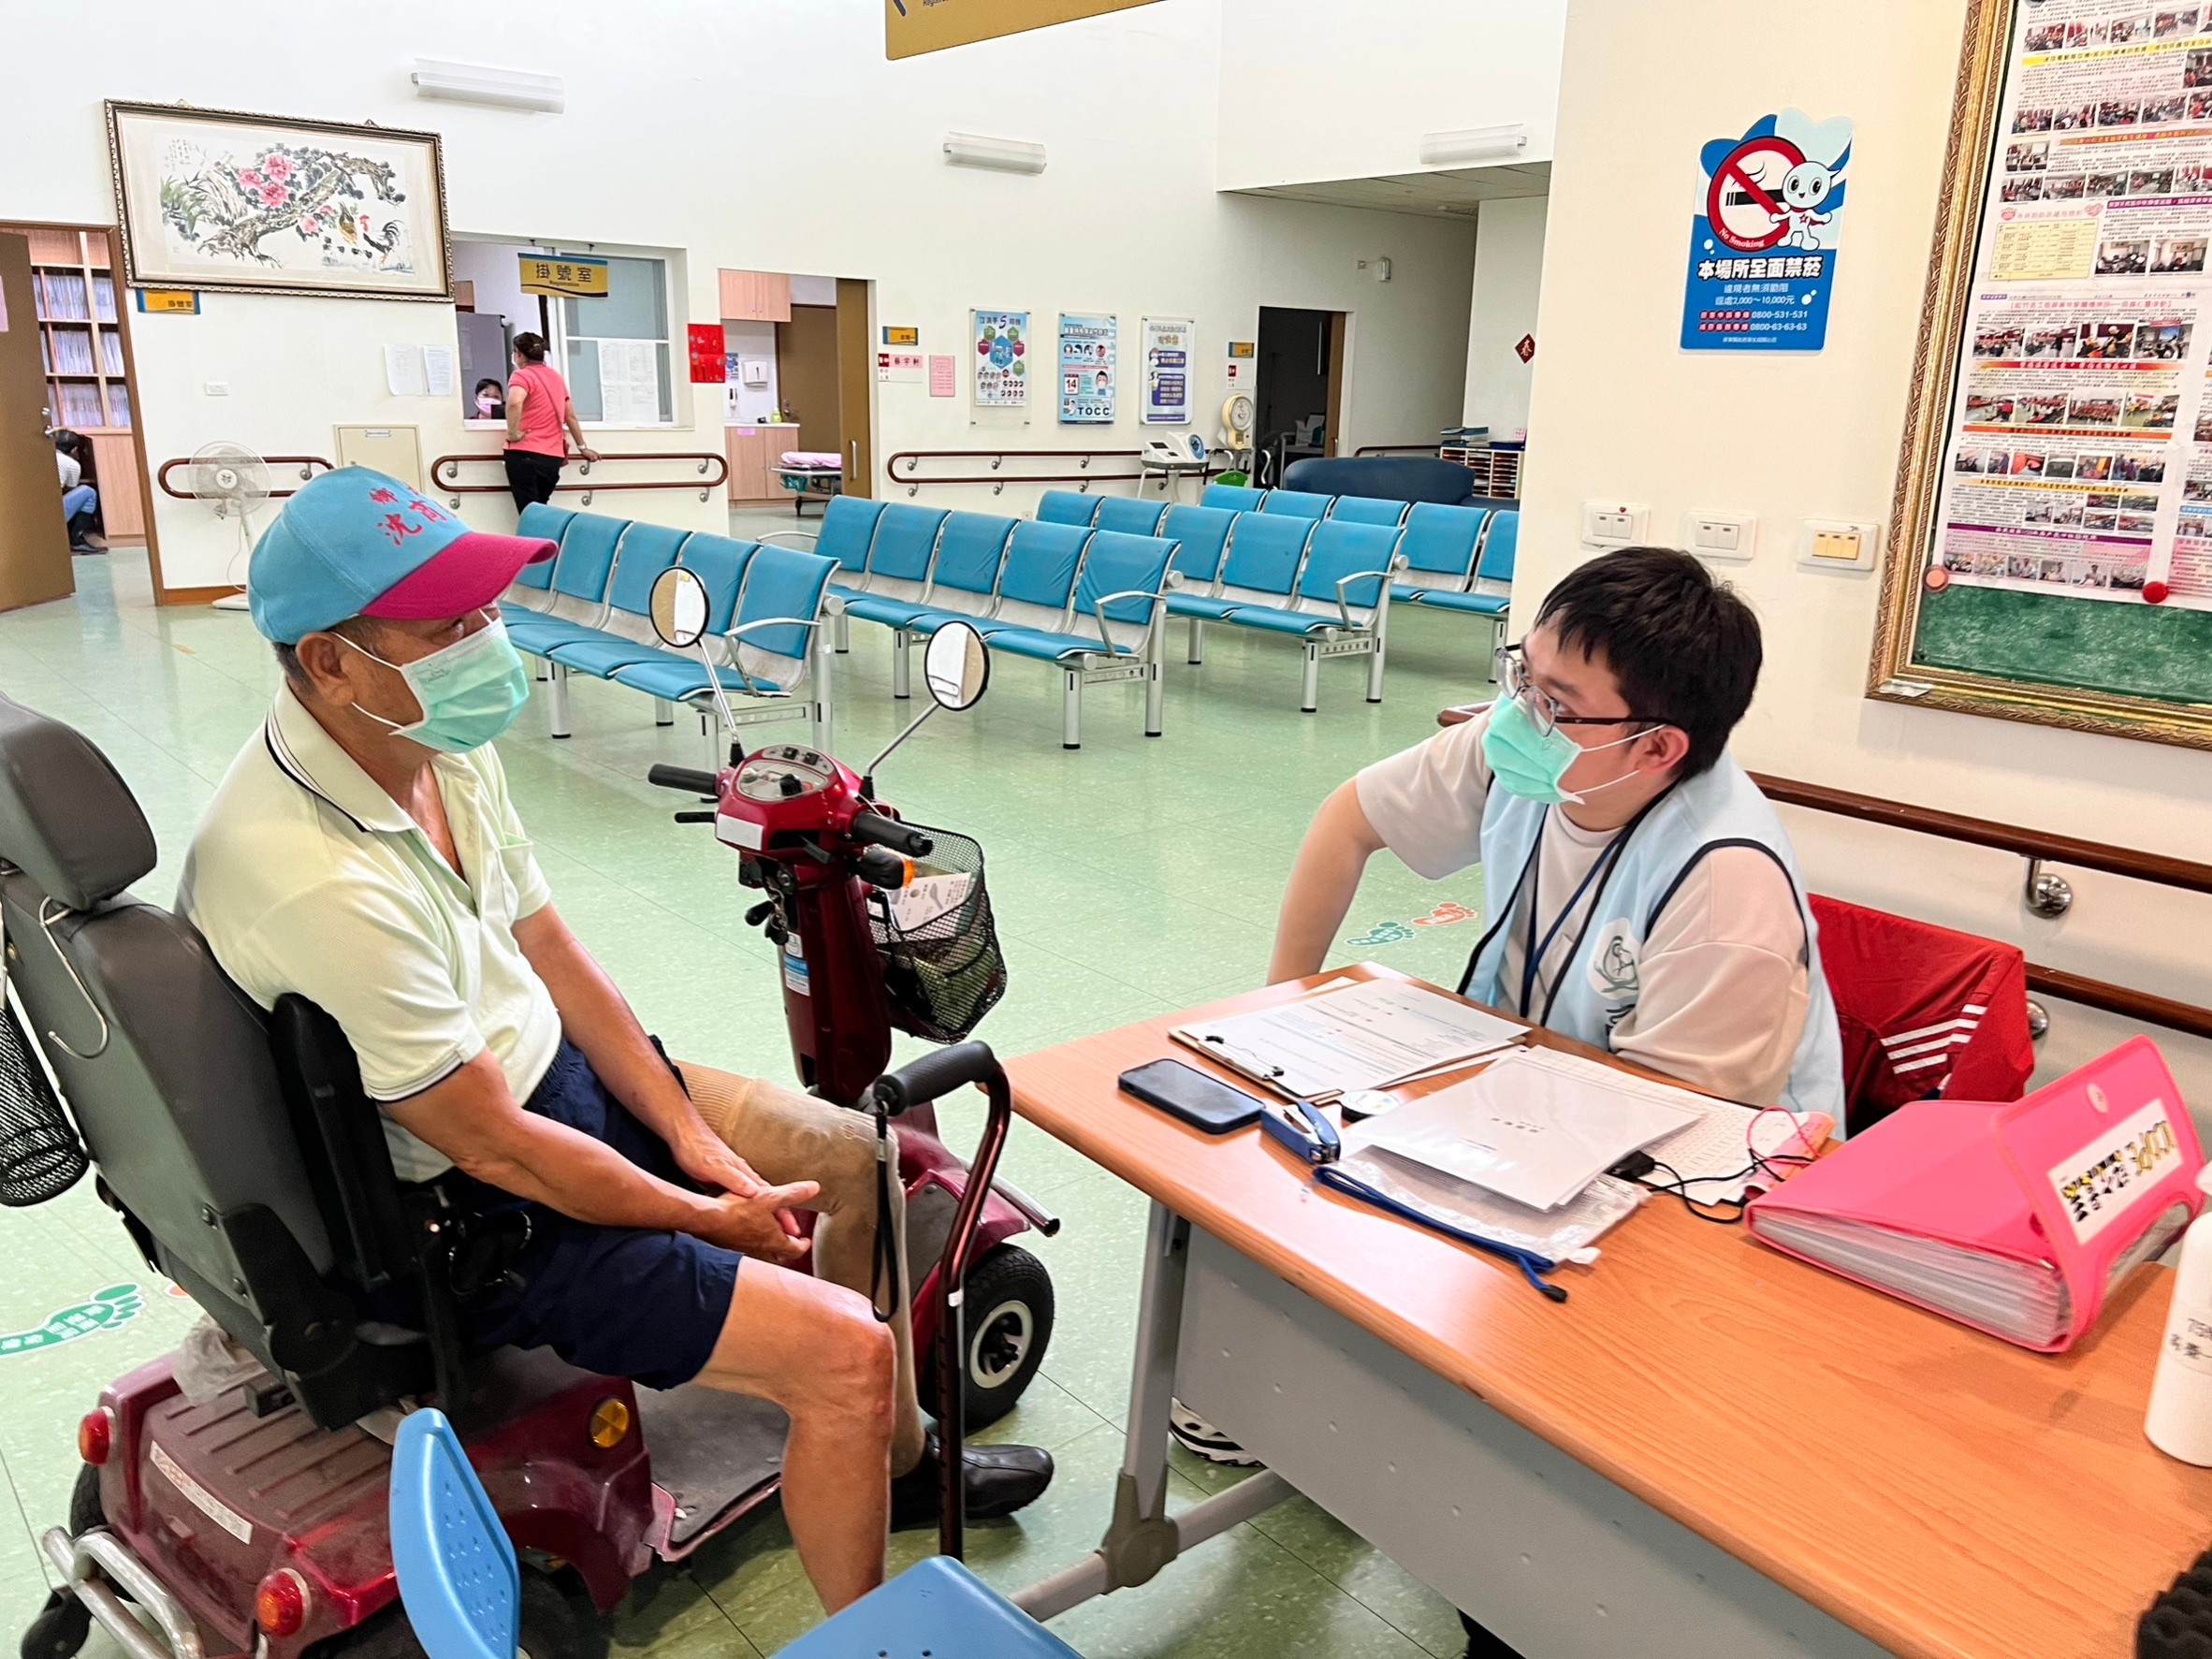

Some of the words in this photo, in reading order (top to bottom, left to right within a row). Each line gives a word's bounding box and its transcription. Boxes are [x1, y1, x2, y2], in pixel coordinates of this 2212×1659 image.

[1719, 228, 1731, 241] No
[1729, 236, 1765, 249] Smoking
[536, 263, 591, 283] 掛號室
[1697, 256, 1823, 280] 本場所全面禁菸
[1751, 310, 1808, 319] 0800-531-531
[1750, 323, 1808, 331] 0800-63-63-63
[1066, 379, 1077, 389] 14
[1077, 406, 1111, 416] TOCC
